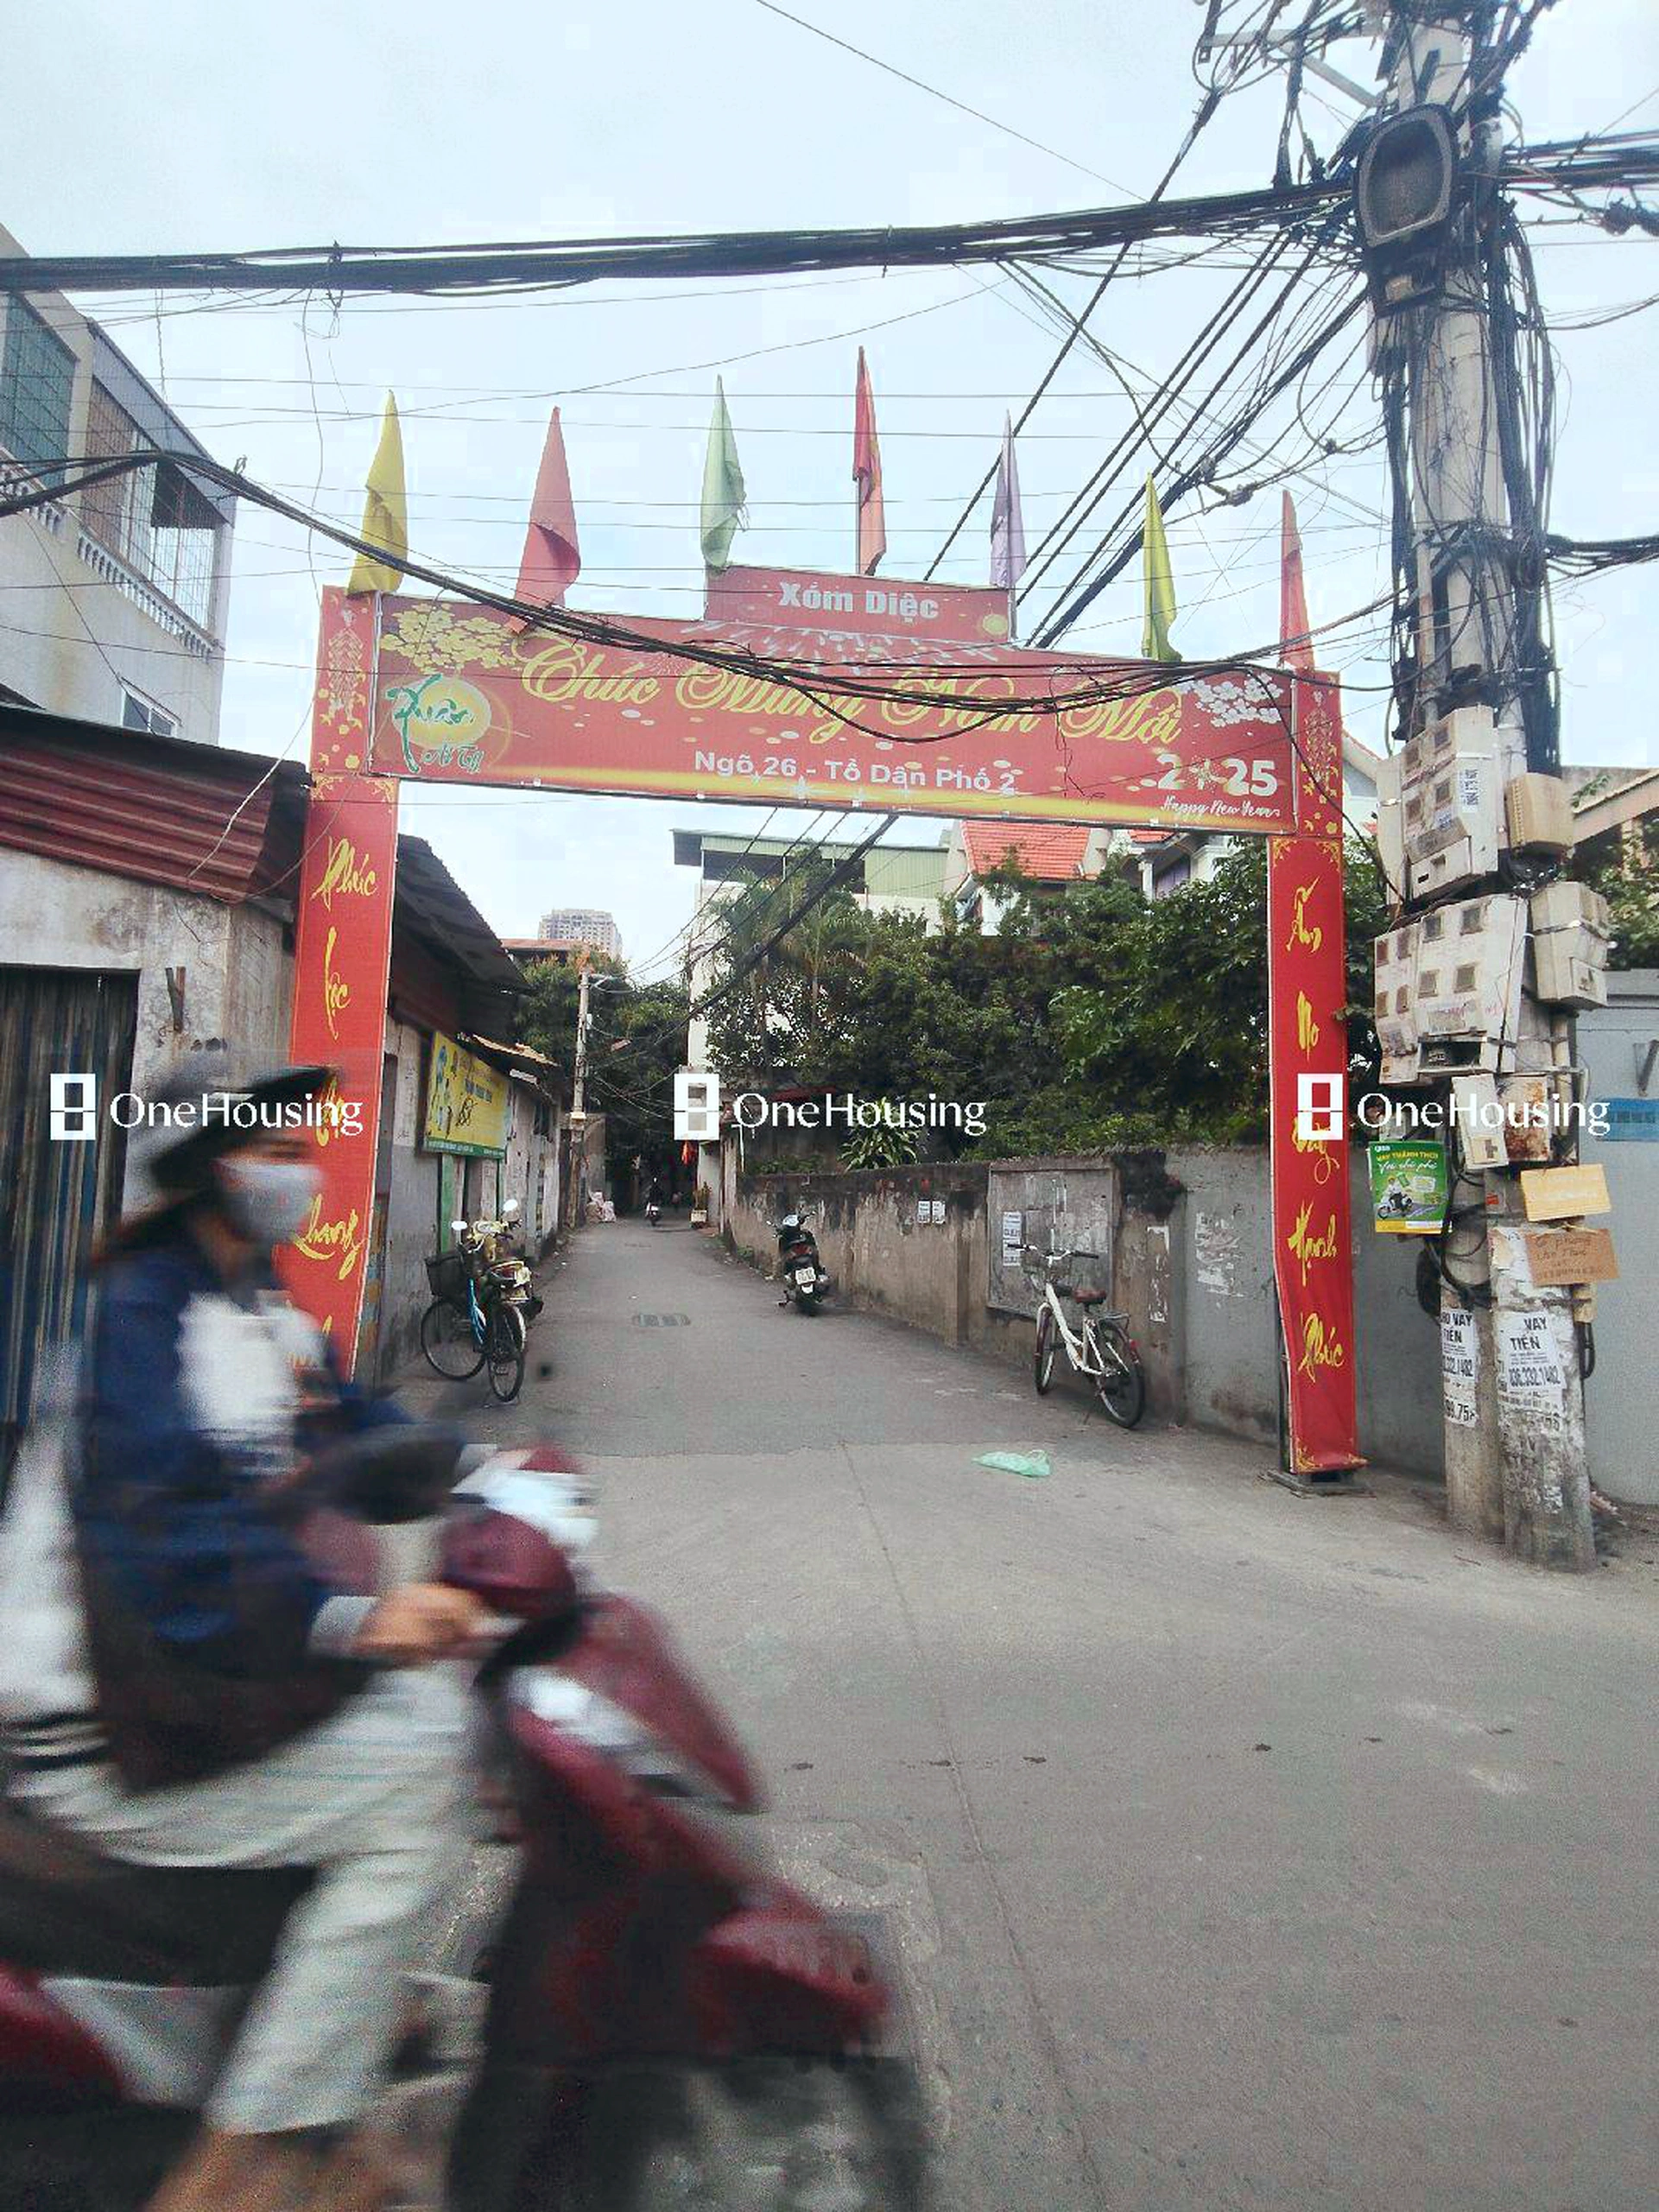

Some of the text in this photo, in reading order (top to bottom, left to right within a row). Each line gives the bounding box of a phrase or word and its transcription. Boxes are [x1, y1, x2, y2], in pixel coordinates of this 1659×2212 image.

[779, 581, 939, 624] Xóm Diệc
[512, 633, 662, 705] Chúc
[695, 751, 754, 776] Ngõ
[763, 757, 796, 776] 26
[871, 764, 926, 786] Dân
[936, 768, 991, 790] Phố
[999, 772, 1016, 795] 2
[1452, 1313, 1472, 1327] VAY
[1523, 1317, 1548, 1331] VAY
